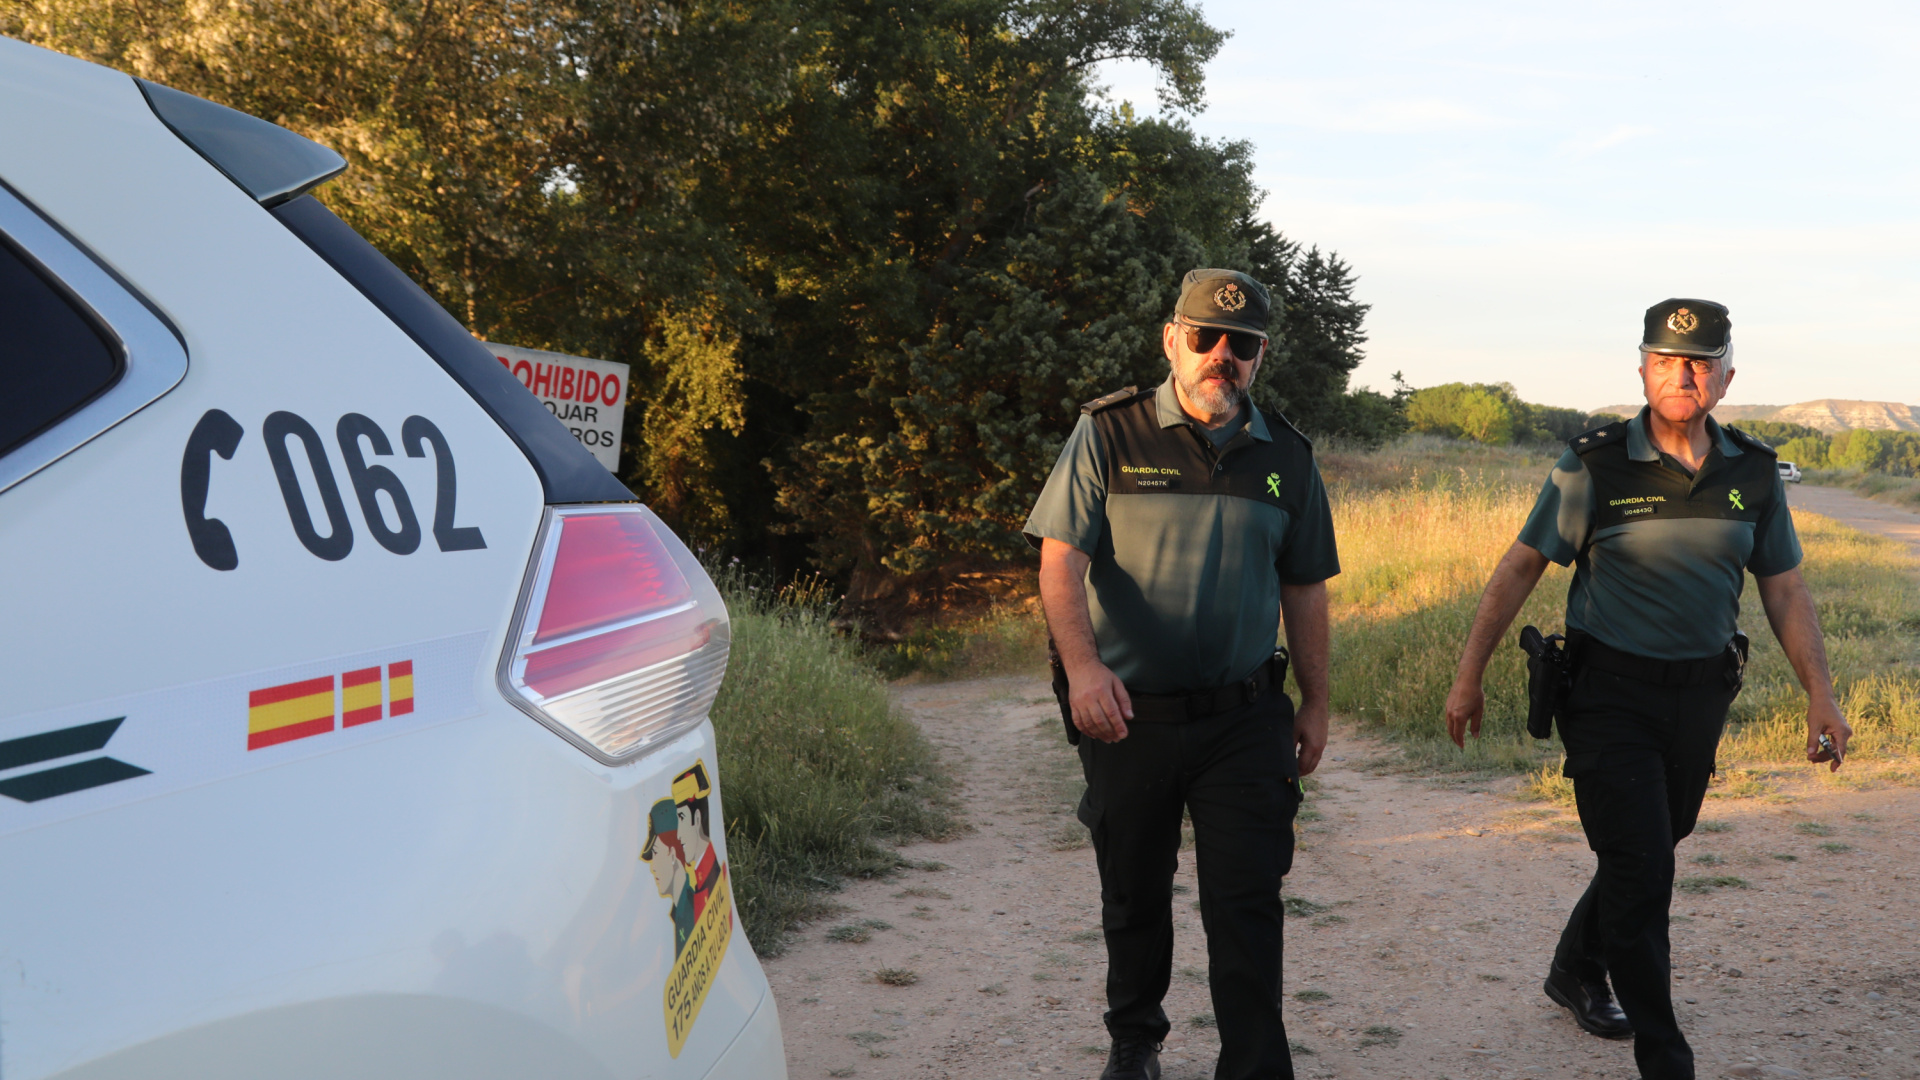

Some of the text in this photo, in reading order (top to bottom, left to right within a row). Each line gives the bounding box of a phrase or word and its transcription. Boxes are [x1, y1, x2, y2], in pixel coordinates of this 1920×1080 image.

[262, 410, 488, 562] 062
[1121, 465, 1181, 476] GUARDIA CIVIL
[1609, 495, 1667, 506] GUARDIA CIVIL
[667, 886, 725, 1011] GUARDIA CIVIL
[672, 990, 692, 1041] 175
[691, 963, 707, 1007] AÑOS
[705, 954, 711, 977] A
[708, 938, 718, 967] TU
